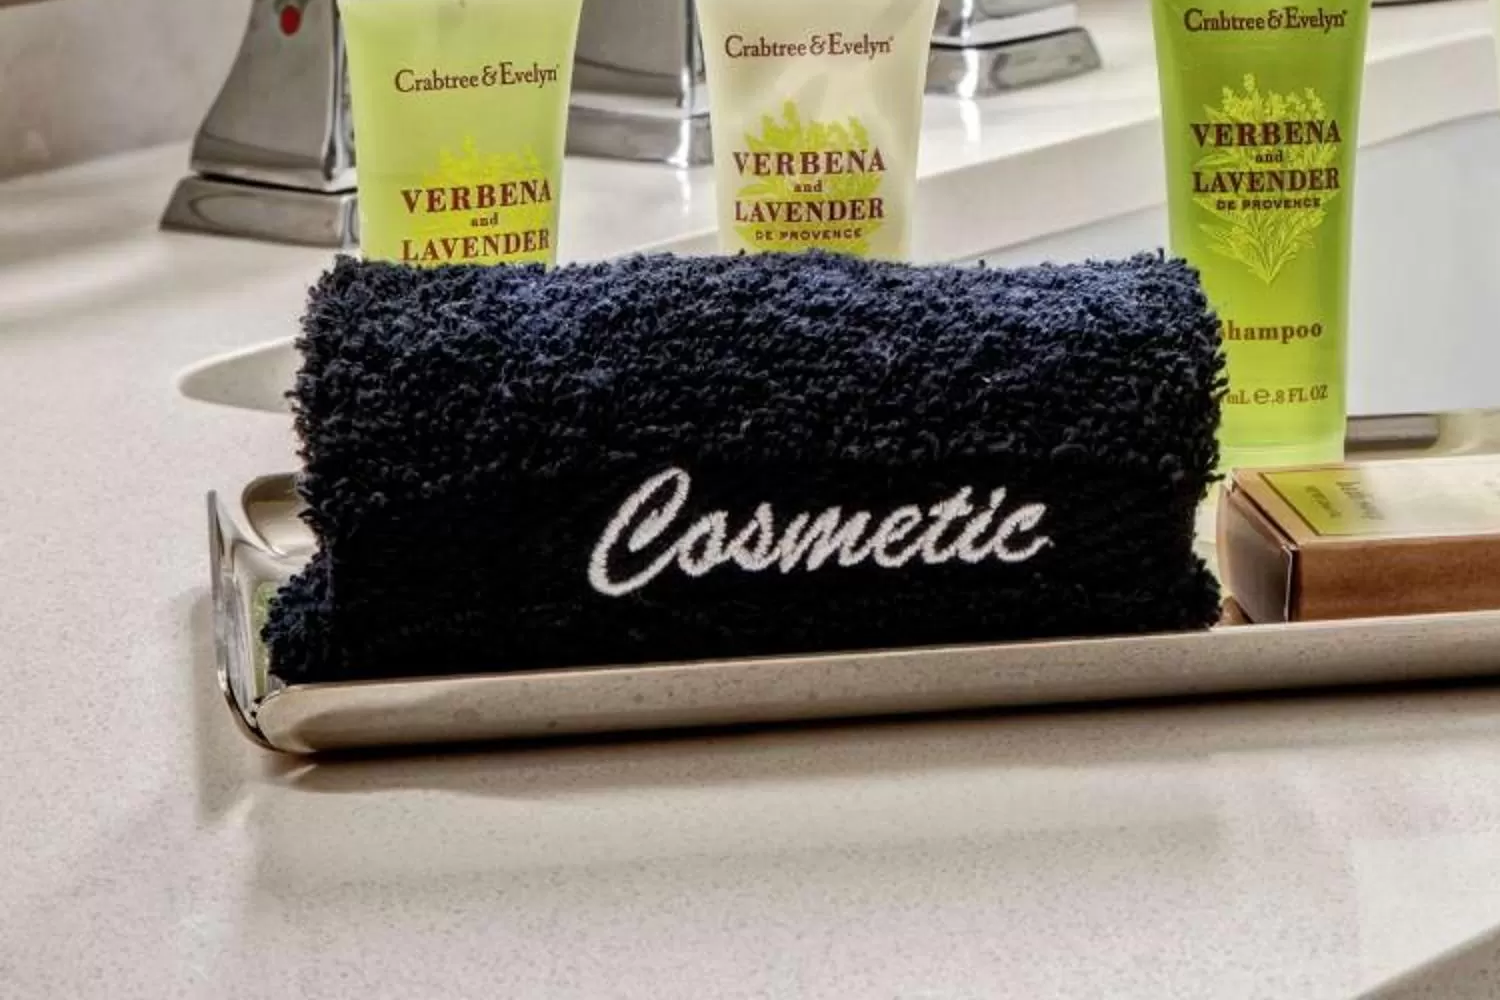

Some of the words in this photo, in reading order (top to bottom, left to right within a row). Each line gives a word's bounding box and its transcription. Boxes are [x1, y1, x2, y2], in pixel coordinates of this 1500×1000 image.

[1190, 120, 1341, 147] VERBENA
[732, 146, 887, 176] VERBENA
[1256, 150, 1283, 163] and
[794, 180, 822, 192] and
[1192, 167, 1340, 193] LAVENDER
[401, 179, 552, 213] VERBENA
[1216, 200, 1236, 210] DE
[1242, 198, 1321, 210] PROVENCE
[470, 212, 499, 227] and
[735, 198, 884, 222] LAVENDER
[401, 228, 549, 261] LAVENDER
[755, 230, 773, 240] DE
[780, 228, 862, 240] PROVENCE
[588, 466, 1055, 597] Cosmetic
